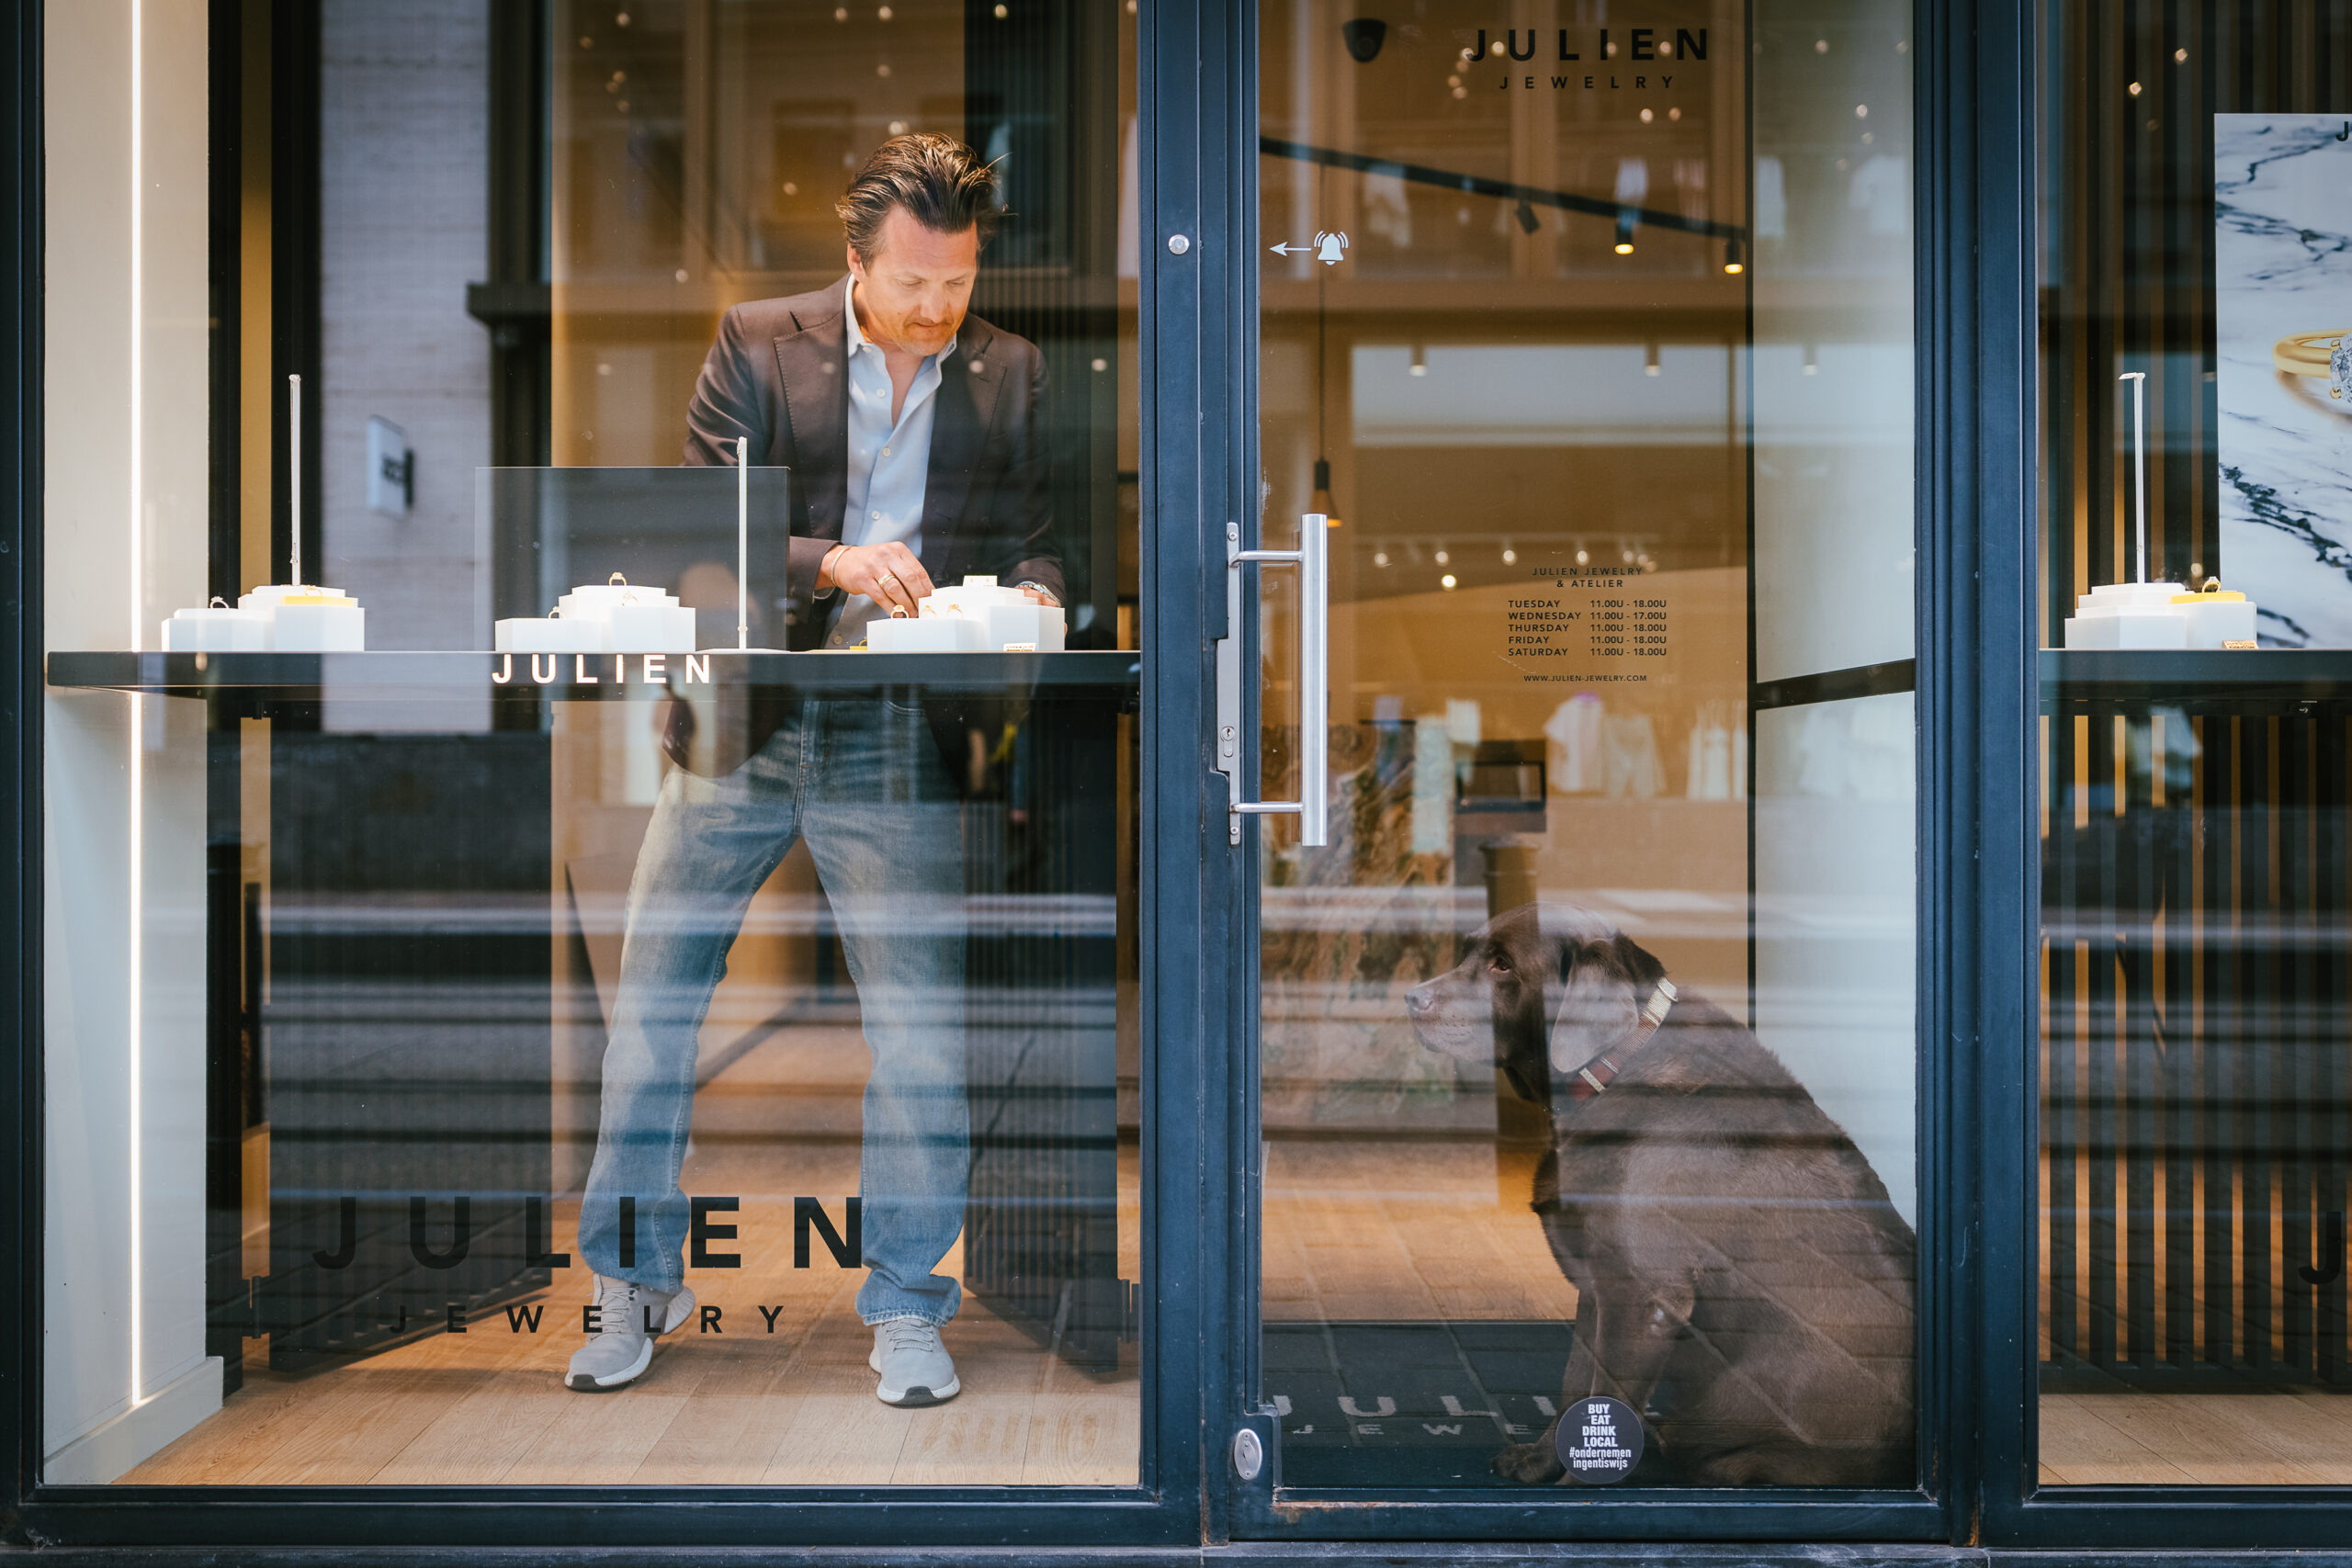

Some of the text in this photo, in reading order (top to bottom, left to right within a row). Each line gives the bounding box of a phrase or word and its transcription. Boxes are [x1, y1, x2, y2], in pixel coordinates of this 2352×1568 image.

[1467, 28, 1707, 62] JULIEN
[1499, 76, 1673, 89] JEWELRY
[1532, 568, 1643, 576] JULIEN JEWELRY
[1556, 580, 1623, 588] & ATELIER
[1508, 600, 1561, 608] TUESDAY
[1589, 600, 1623, 608] 11.00U
[1633, 600, 1667, 608] 18.00U
[1508, 612, 1581, 620] WEDNESDAY
[1589, 612, 1623, 620] 11.00U
[1633, 612, 1667, 620] 17.00U
[1508, 624, 1569, 632] THURSDAY
[1589, 624, 1623, 632] 11.00U
[1633, 624, 1667, 632] 18.00U
[1508, 636, 1550, 644] FRIDAY
[1589, 636, 1623, 644] 11.00U
[1633, 636, 1667, 644] 18.00U
[1508, 648, 1568, 656] SATURDAY
[1589, 648, 1623, 656] 11.00U
[1633, 648, 1667, 656] 18.00U
[492, 654, 710, 684] JULIEN
[311, 1196, 863, 1269] JULIEN
[390, 1305, 785, 1334] JEWELRY
[1588, 1404, 1610, 1414] BUY
[1590, 1415, 1611, 1425] EAT
[1582, 1426, 1616, 1436] DRINK
[1584, 1437, 1618, 1447] LOCAL
[1569, 1447, 1632, 1458] #ondernemen
[1573, 1457, 1628, 1471] ingentiswijs
